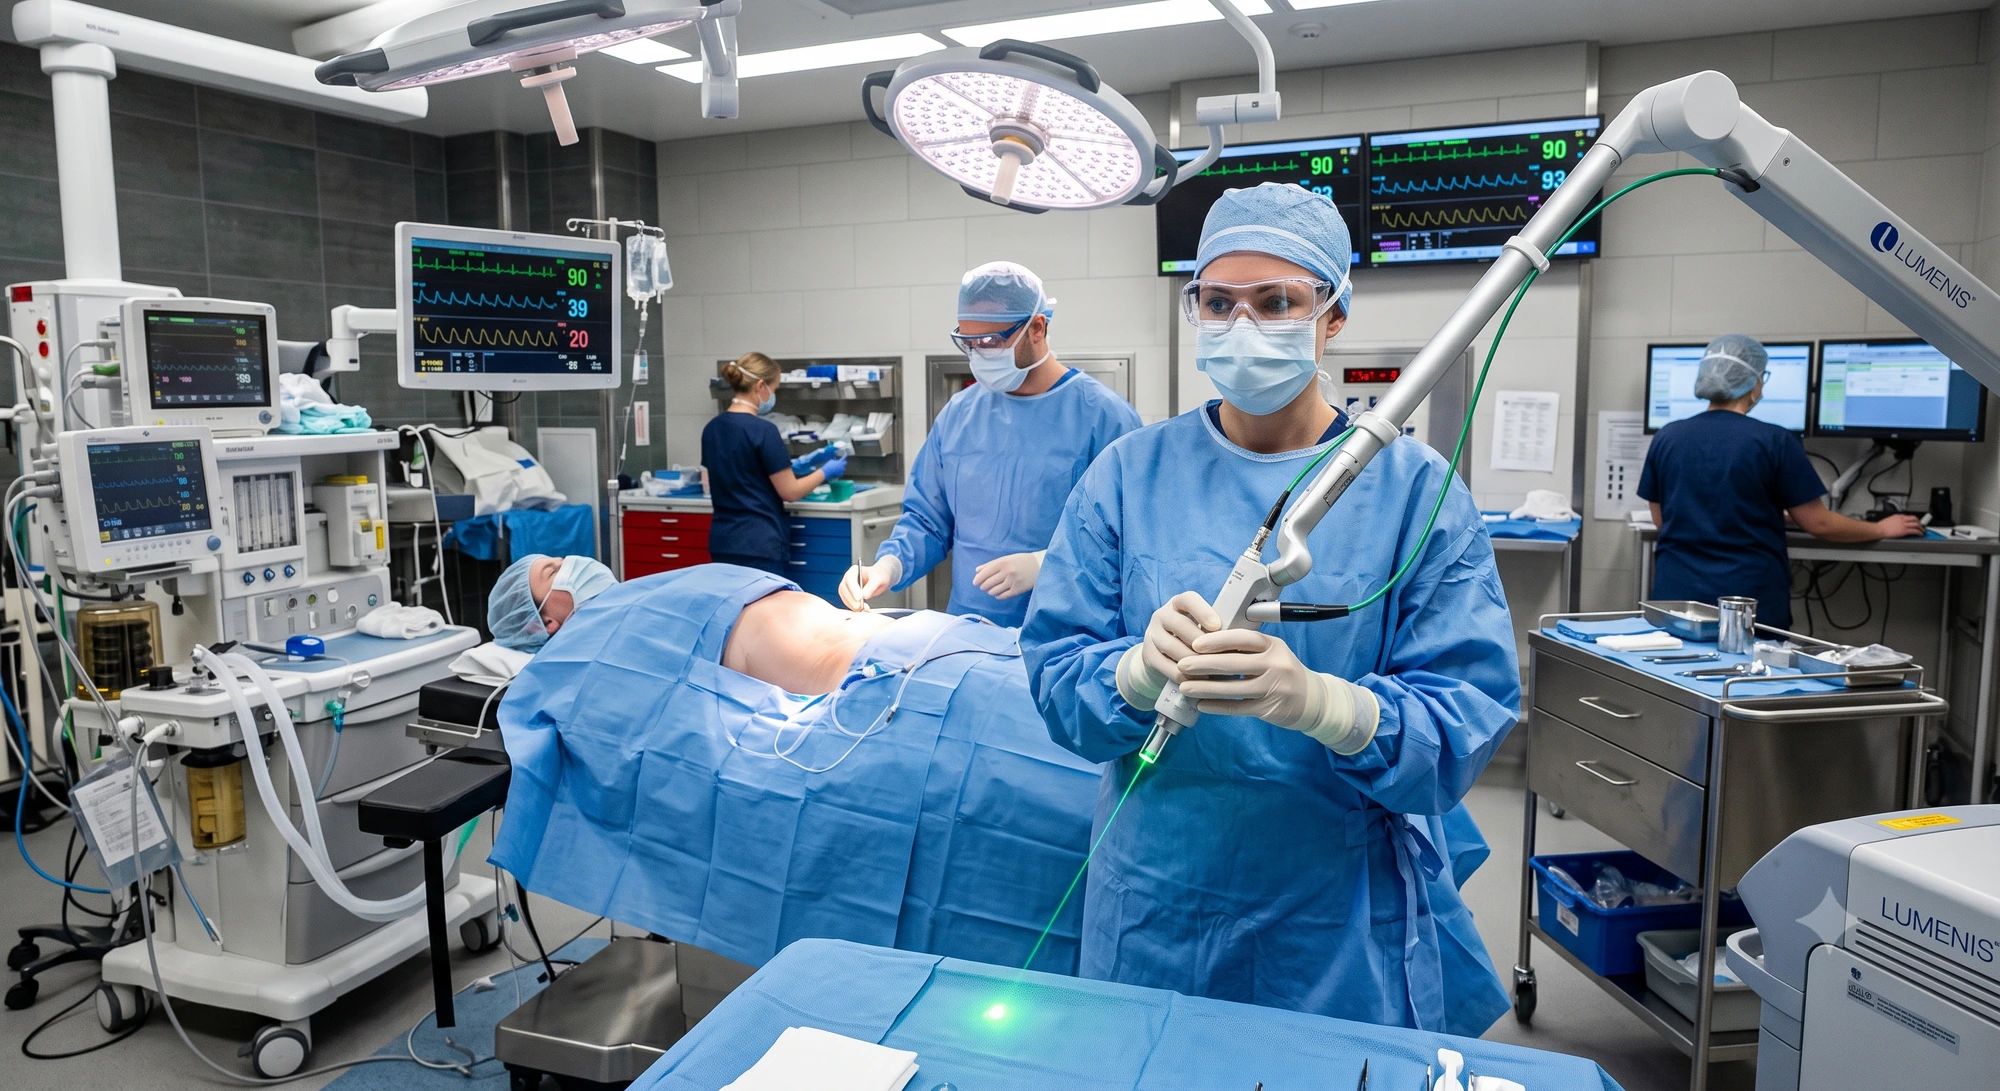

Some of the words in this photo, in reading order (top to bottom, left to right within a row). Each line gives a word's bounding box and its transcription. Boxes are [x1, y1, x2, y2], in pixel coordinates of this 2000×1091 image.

[1542, 139, 1567, 160] 90
[1311, 155, 1333, 175] 90
[1541, 169, 1567, 190] 93
[567, 268, 588, 287] 90
[1894, 242, 1971, 308] LUMENIS
[568, 299, 588, 317] 39
[569, 330, 589, 348] 20
[1882, 896, 1994, 963] LUMENIS
